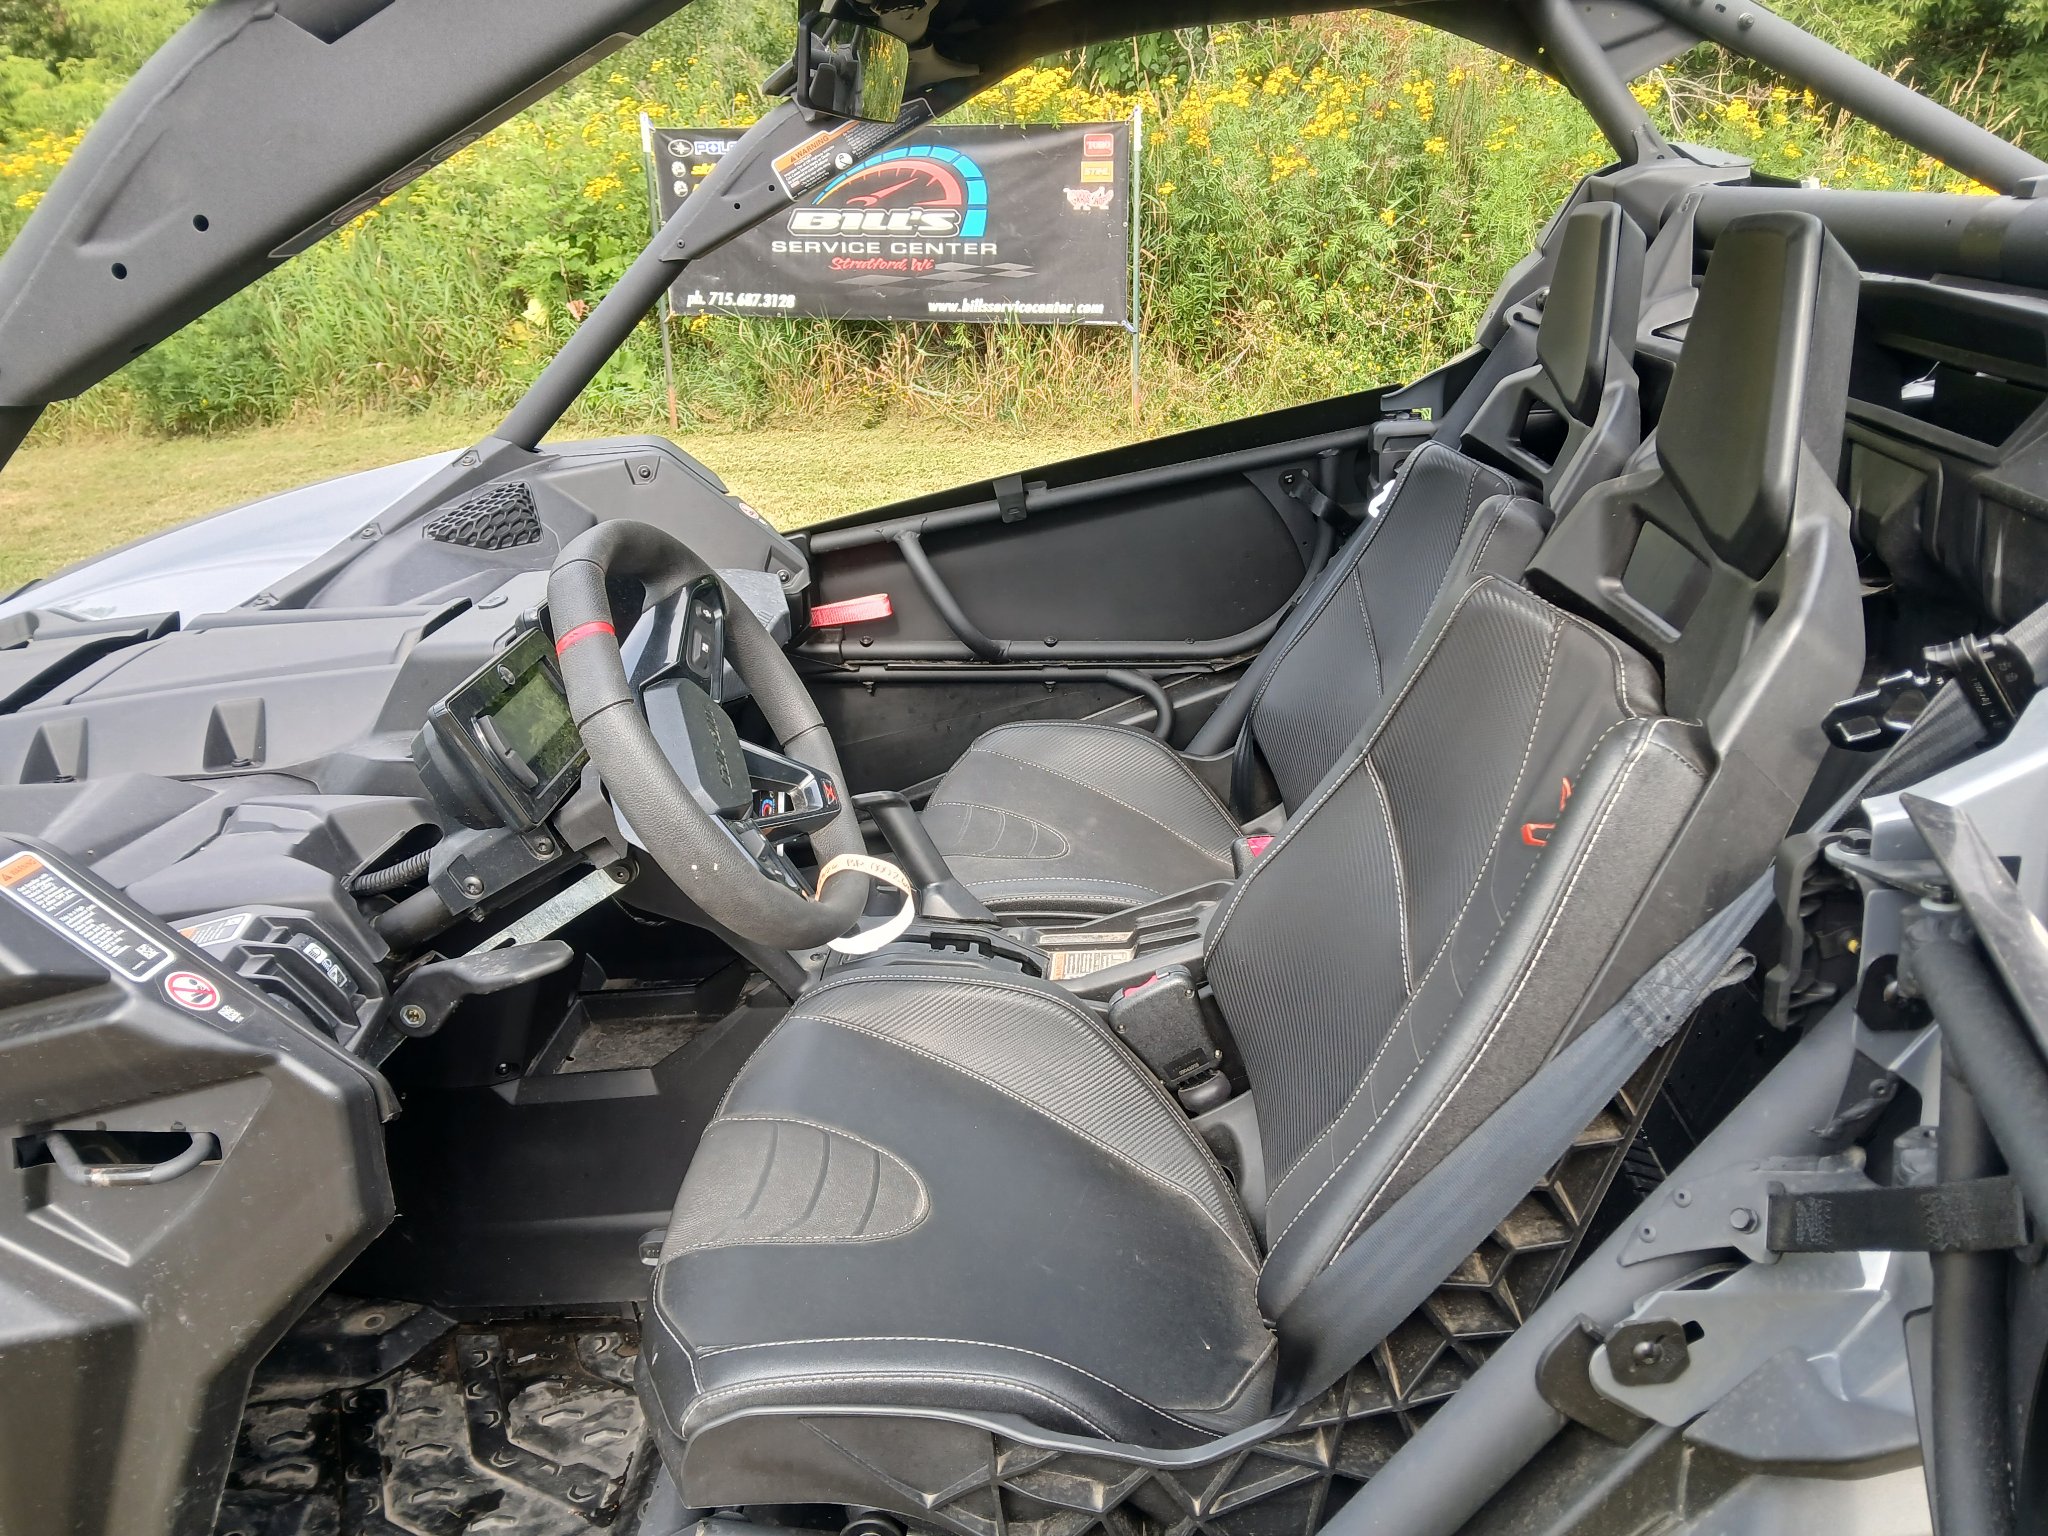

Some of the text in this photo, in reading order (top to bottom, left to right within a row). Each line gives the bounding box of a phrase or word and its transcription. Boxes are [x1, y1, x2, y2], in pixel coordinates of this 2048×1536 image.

[795, 135, 829, 159] WARNING
[771, 240, 998, 255] SERVICE CENTER
[829, 256, 908, 273] Stratford,
[686, 289, 704, 307] ph.
